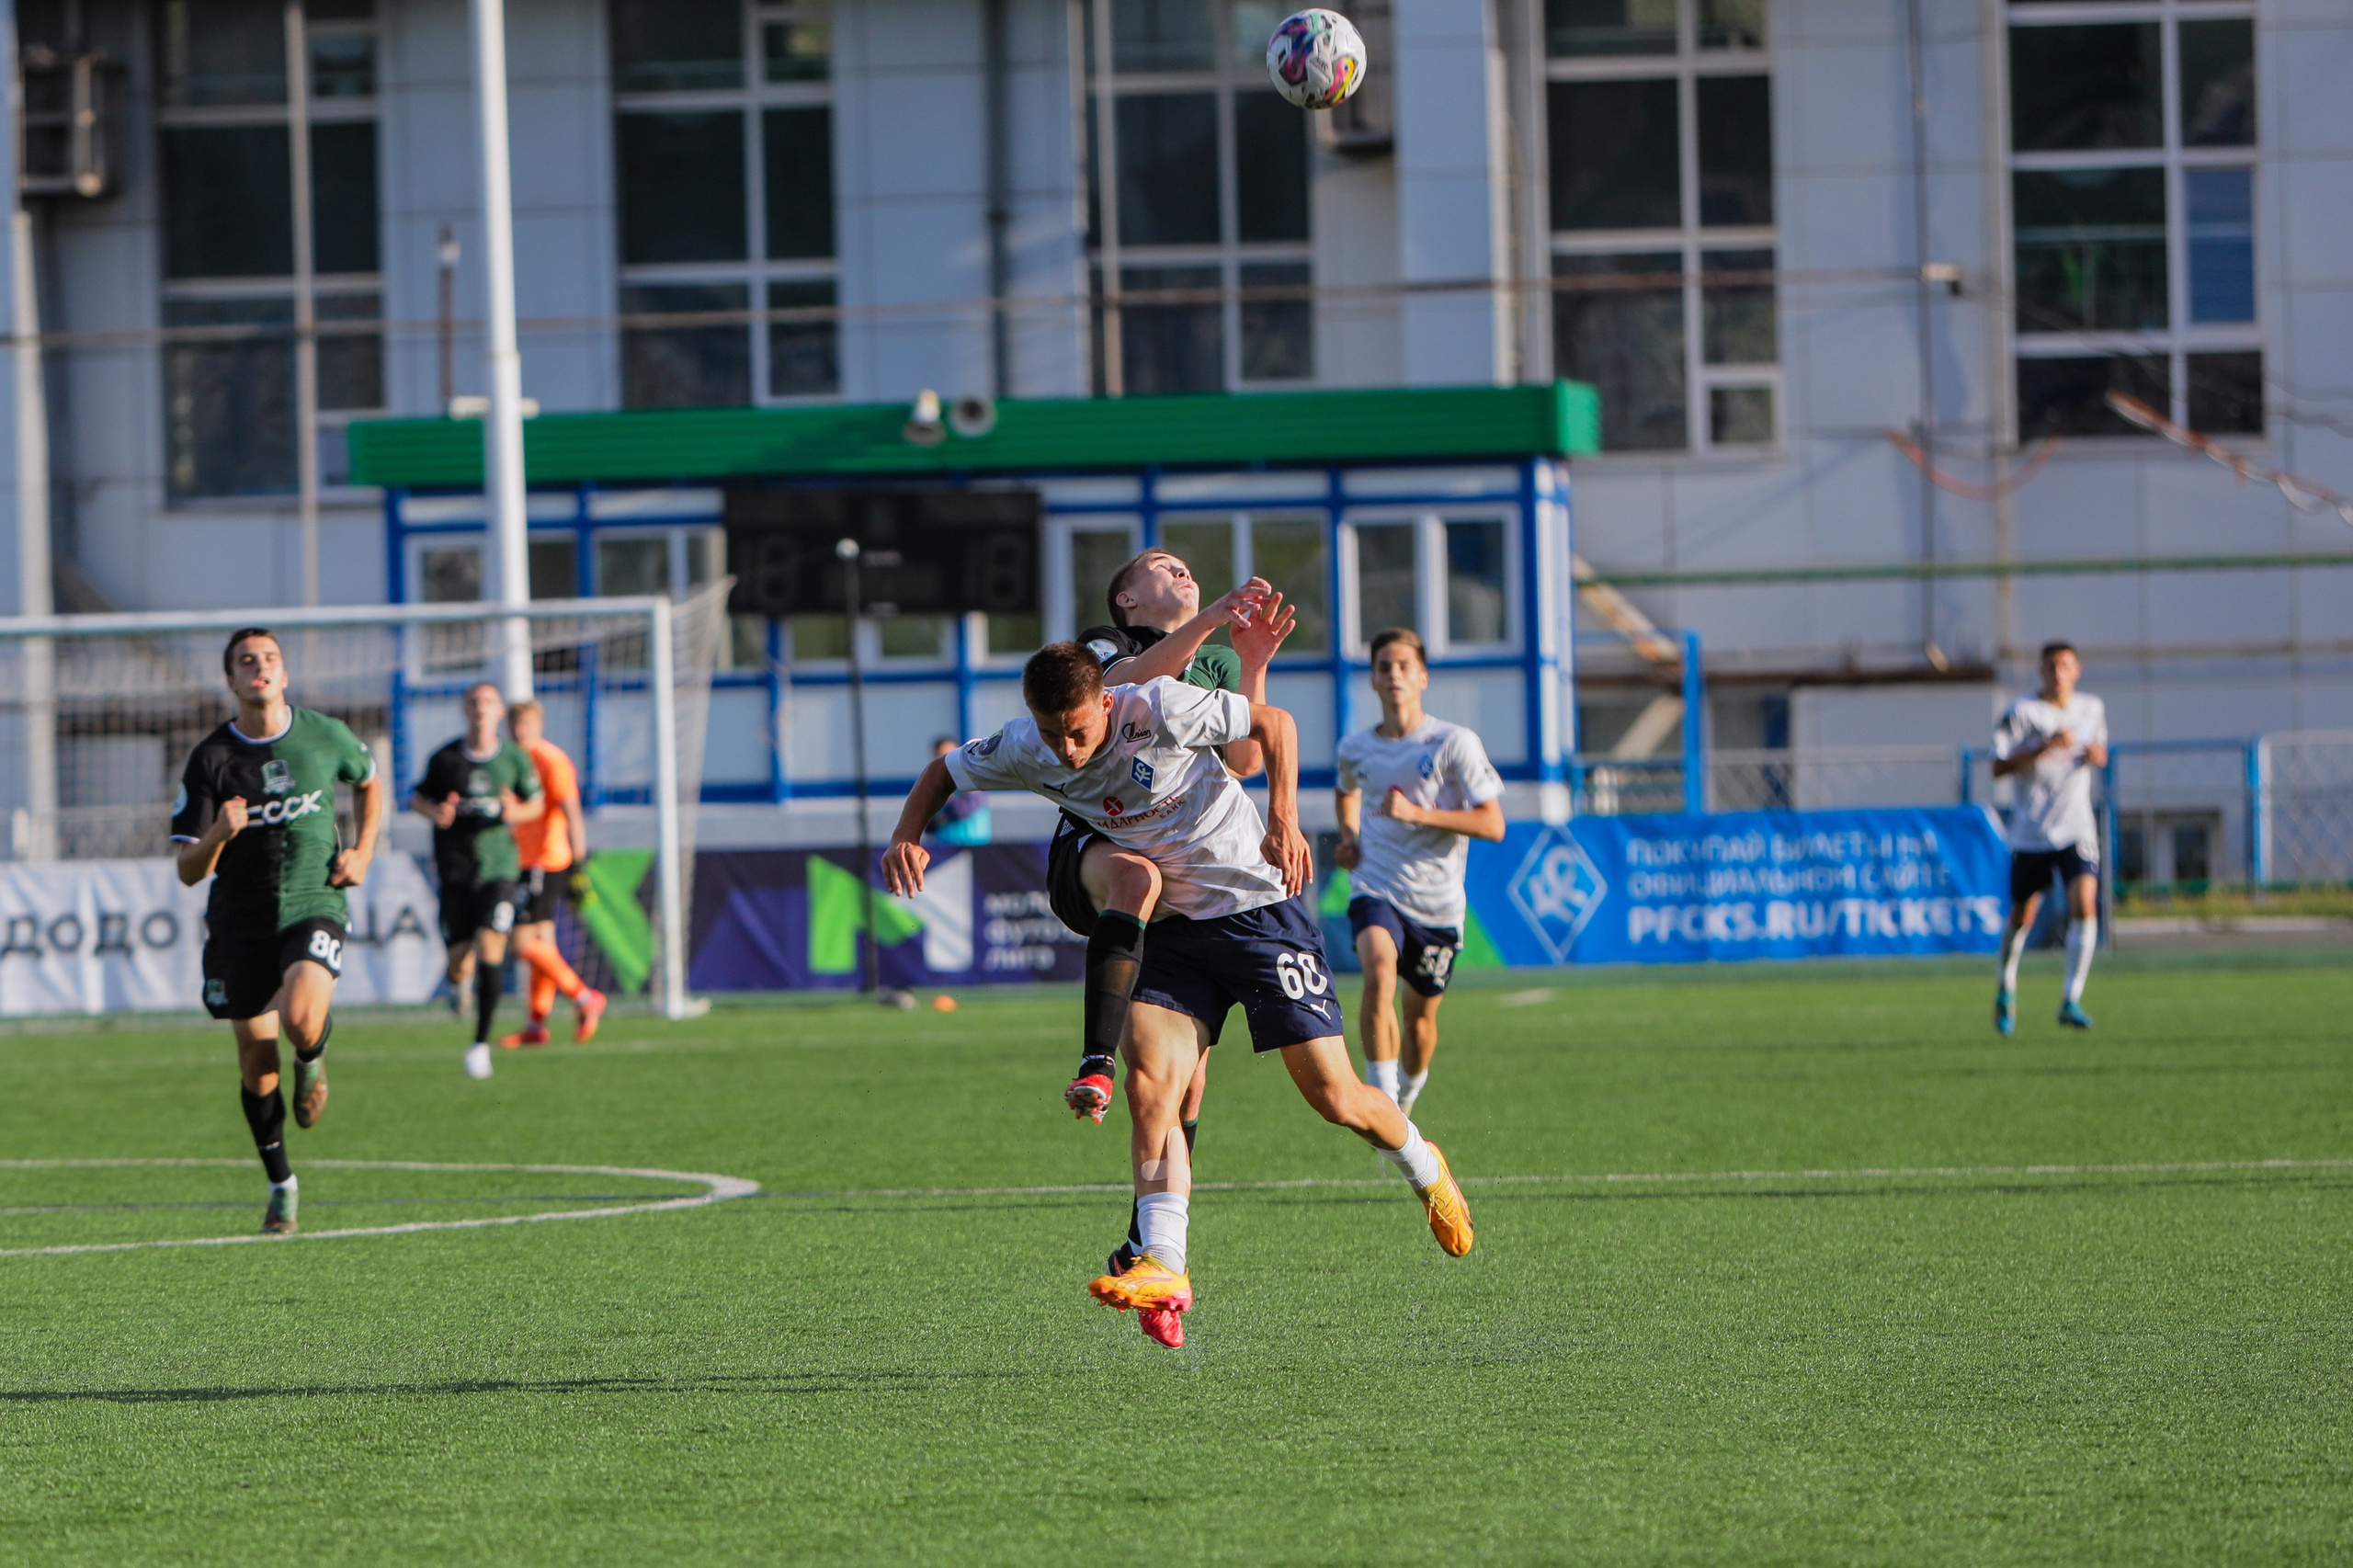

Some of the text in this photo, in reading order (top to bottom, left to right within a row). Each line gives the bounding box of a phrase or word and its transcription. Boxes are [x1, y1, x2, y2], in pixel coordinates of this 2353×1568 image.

[1097, 795, 1179, 830] ИДАРНОСТЬ
[1159, 799, 1185, 820] БАНК
[0, 911, 179, 959] ДОДО
[1628, 896, 2004, 945] PFCKS.RU/TICKETS
[309, 929, 342, 971] 80
[1277, 950, 1328, 1000] 60
